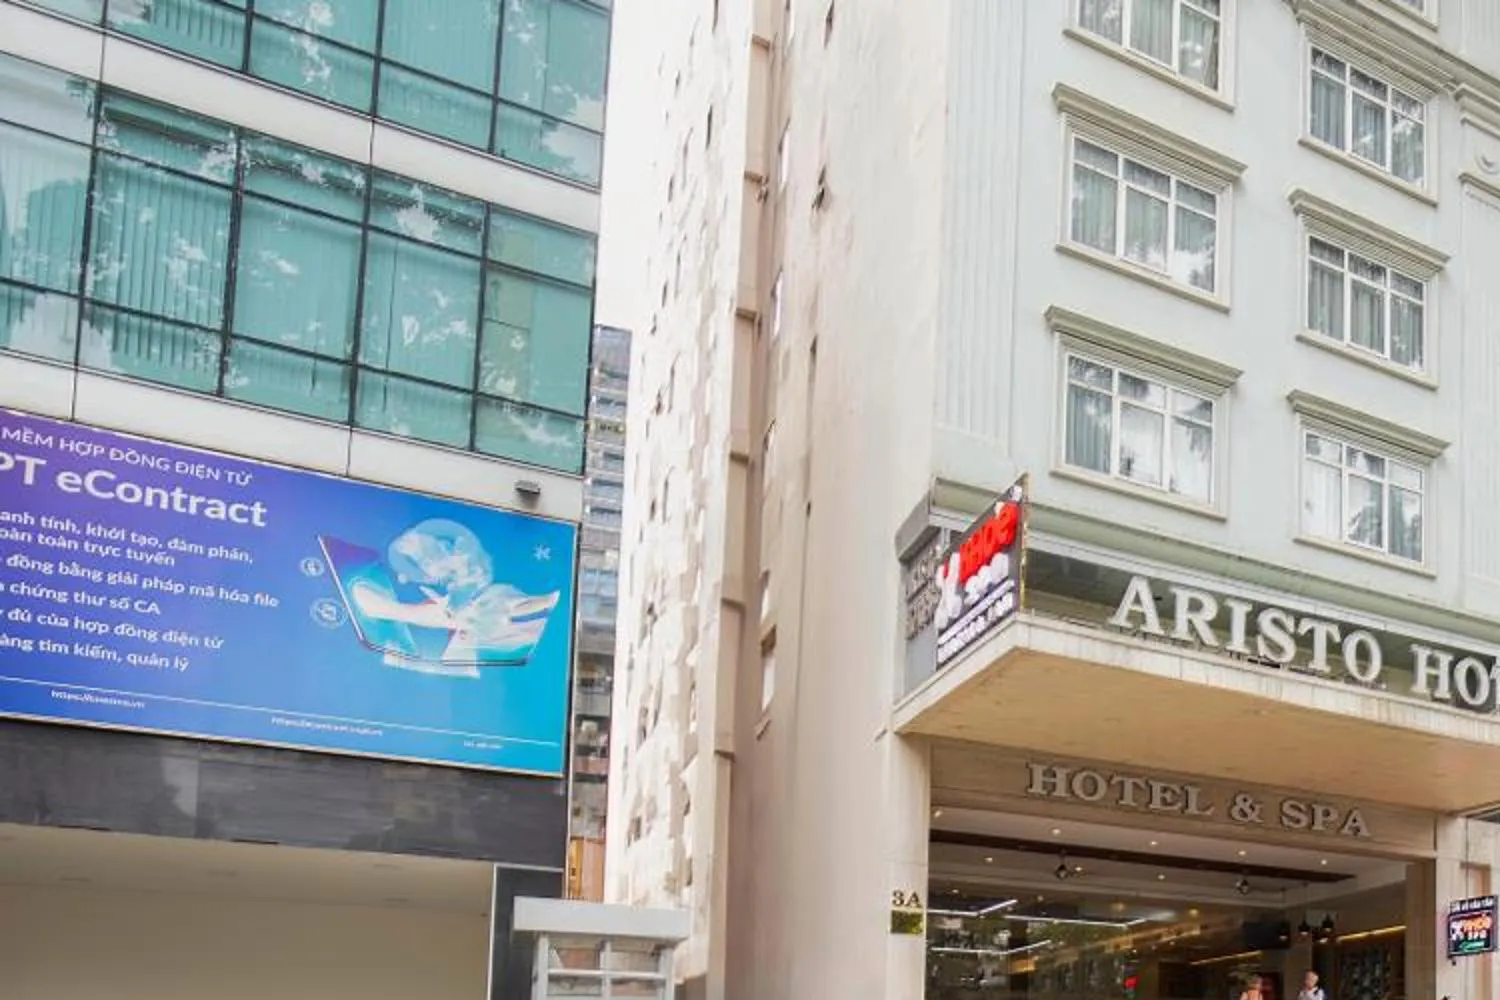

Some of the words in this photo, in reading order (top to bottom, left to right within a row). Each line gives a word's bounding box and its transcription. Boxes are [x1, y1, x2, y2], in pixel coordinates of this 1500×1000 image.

[2, 426, 53, 449] MỀM
[109, 446, 171, 472] ĐỒNG
[56, 468, 268, 528] eContract
[134, 600, 161, 615] CA
[1108, 576, 1384, 683] ARISTO
[1027, 761, 1215, 817] HOTEL
[1230, 792, 1265, 826] &
[1280, 799, 1372, 838] SPA
[892, 889, 923, 909] 3A
